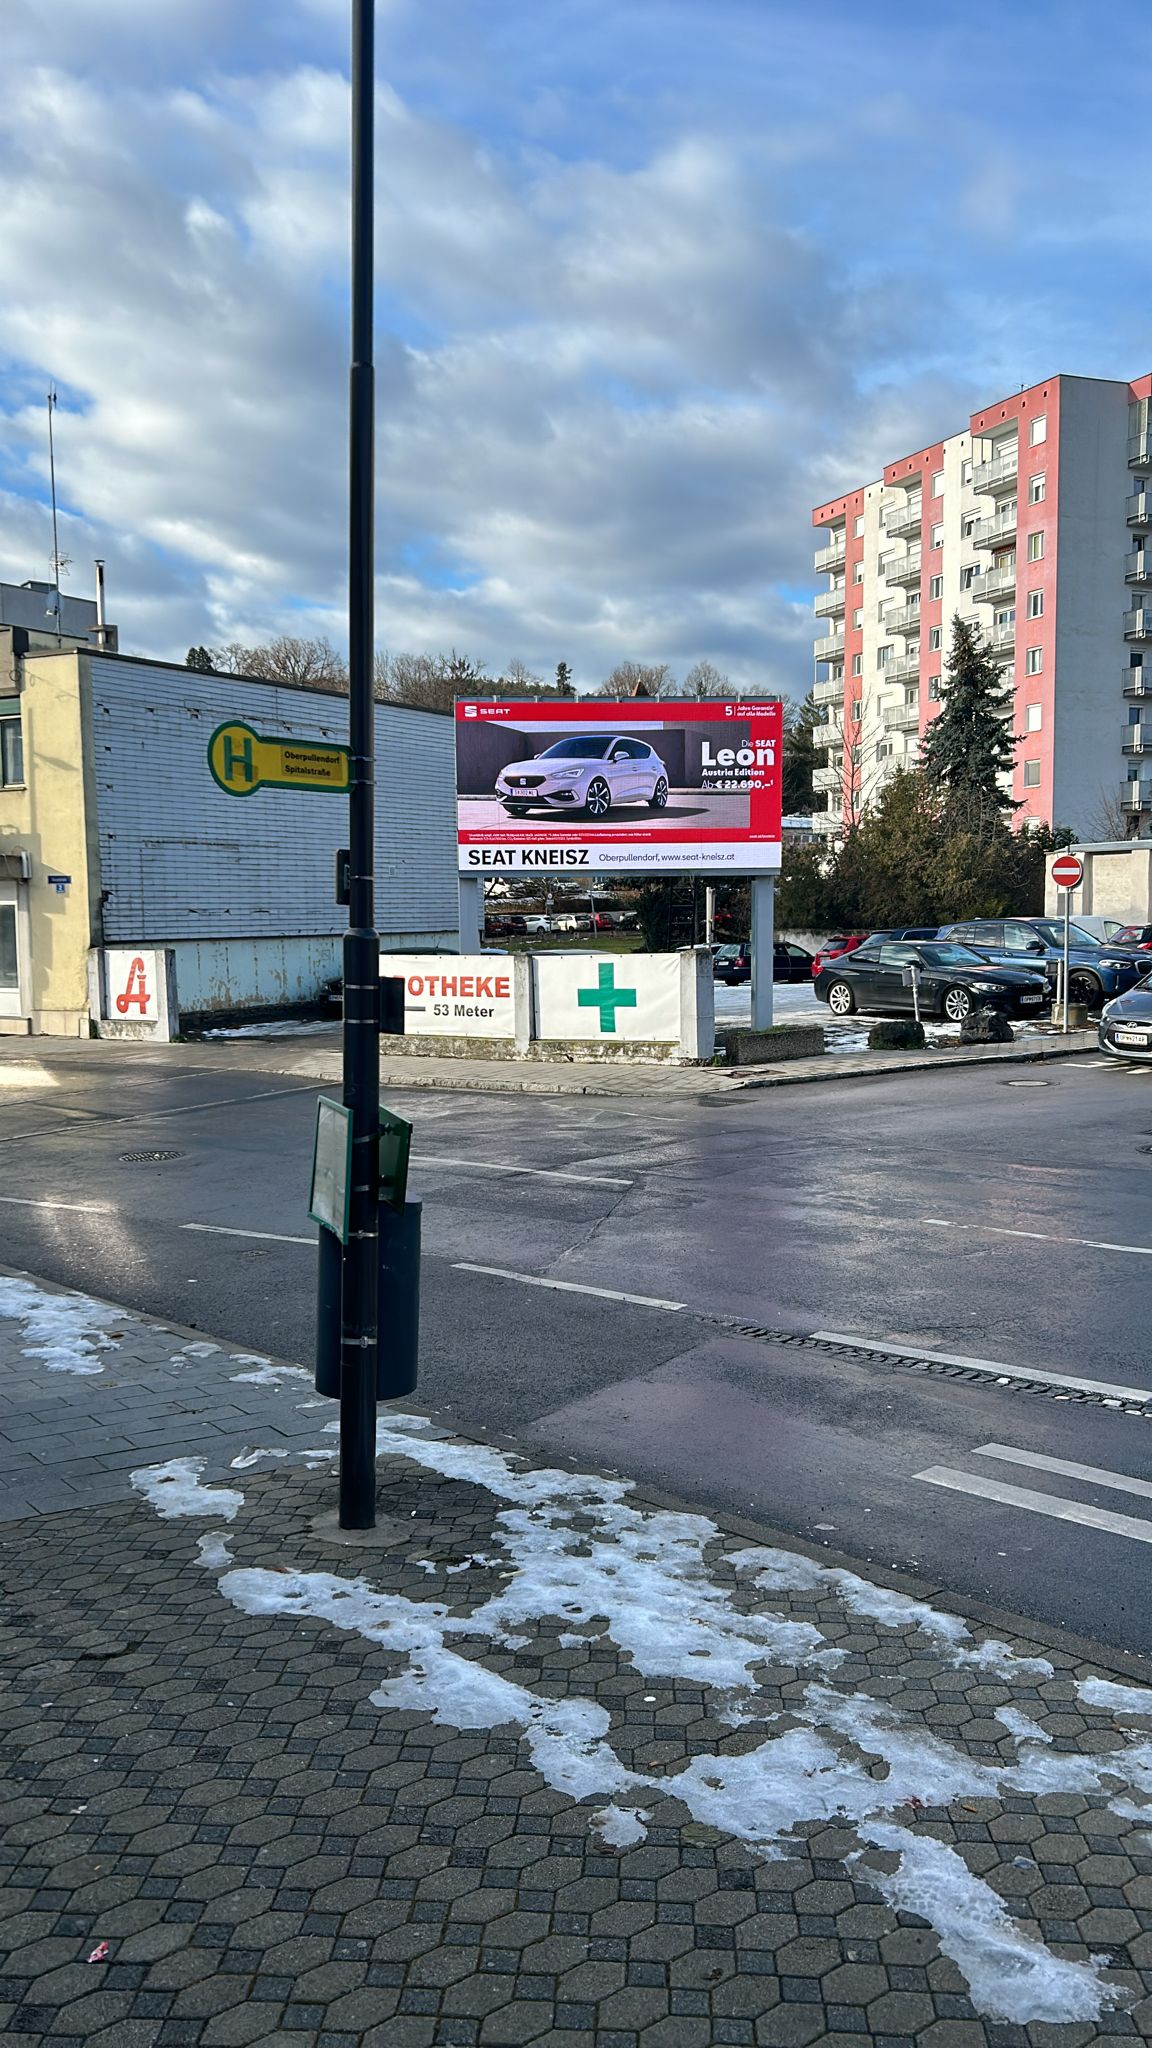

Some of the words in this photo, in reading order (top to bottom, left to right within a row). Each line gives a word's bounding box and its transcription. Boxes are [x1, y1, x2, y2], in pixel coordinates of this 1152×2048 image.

[725, 705, 733, 717] 5
[741, 739, 753, 747] Die
[755, 739, 776, 747] SEAT
[284, 750, 340, 764] Oberpullendorf
[701, 741, 775, 767] Leon
[284, 765, 331, 777] Spitalstraße
[701, 768, 733, 777] Austria
[735, 768, 765, 777] Edition
[701, 780, 714, 789] Ab
[468, 849, 516, 865] SEAT
[521, 849, 590, 865] KNEISZ
[598, 853, 660, 863] Oberpullendorf,
[661, 852, 735, 862] www.seat-kneisz.at
[394, 975, 511, 998] OTHEKE
[433, 1004, 450, 1016] 53
[454, 1004, 495, 1018] Meter
